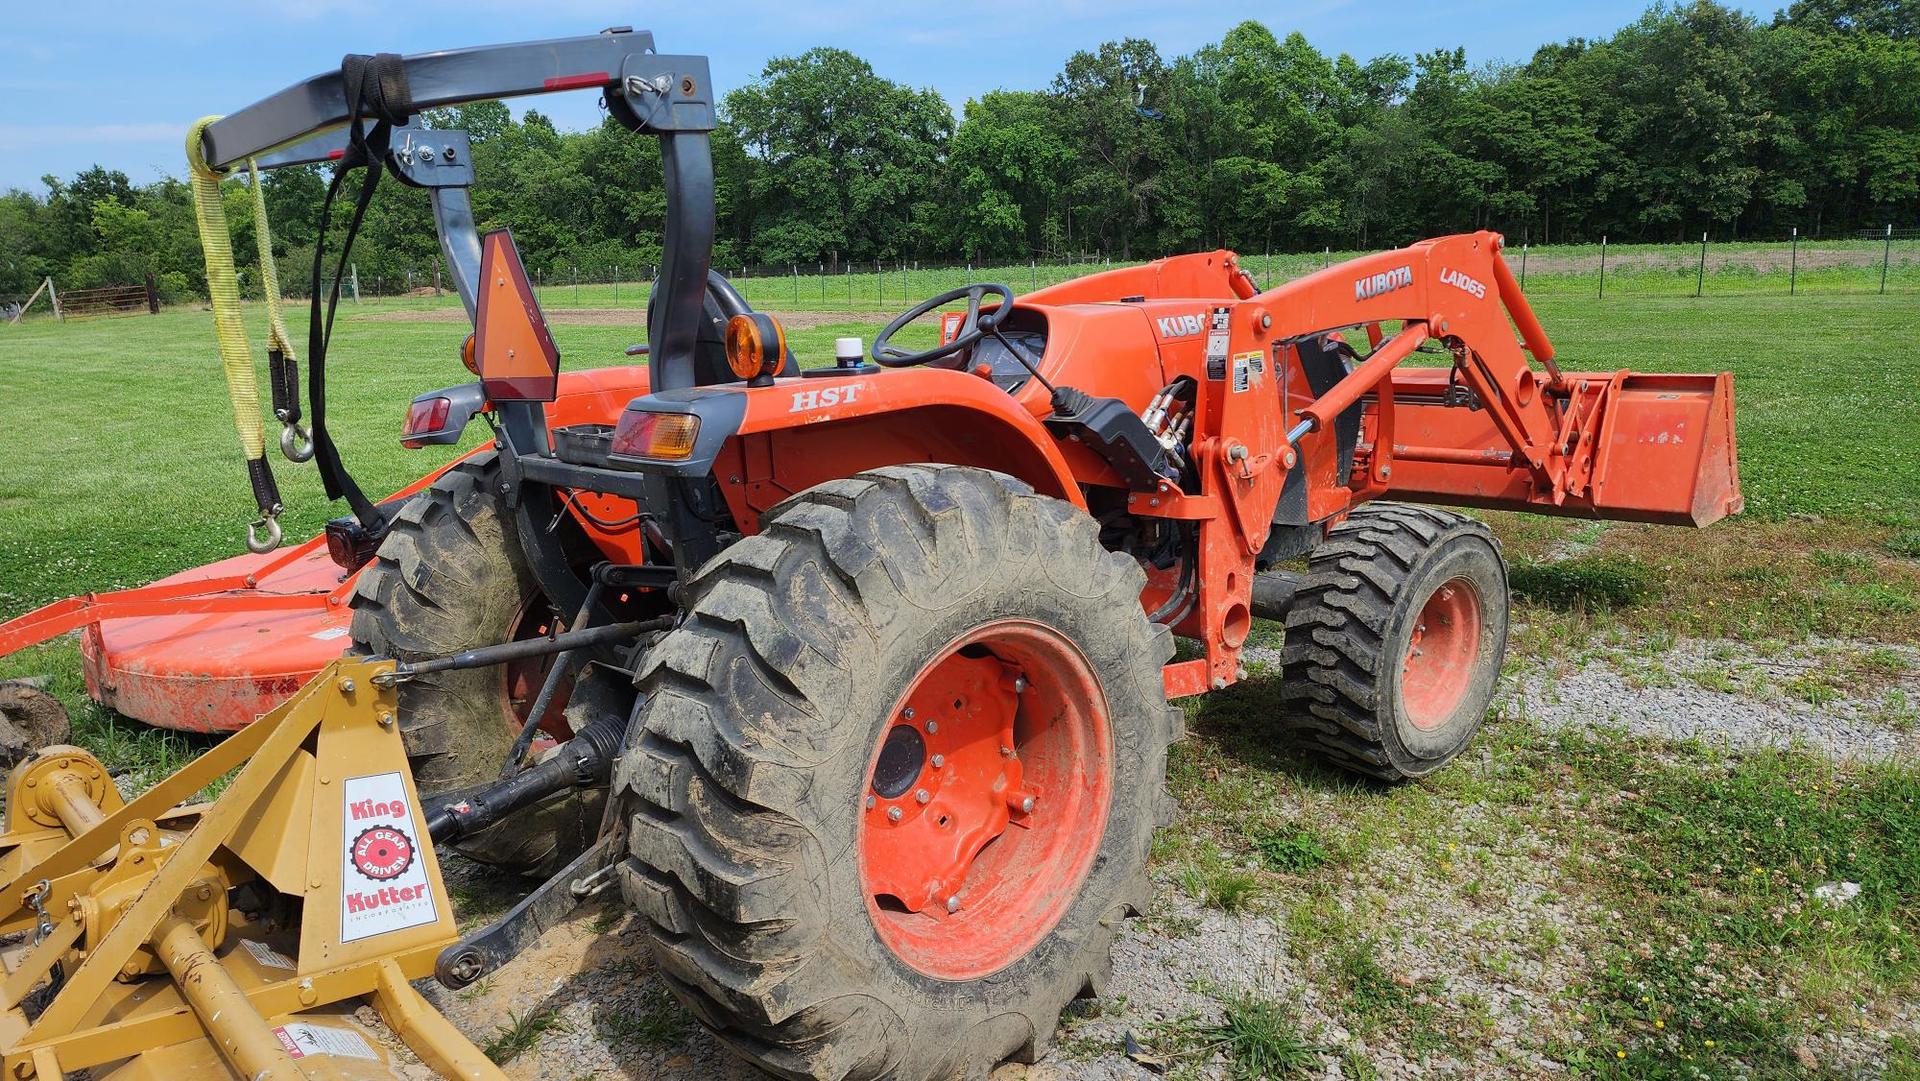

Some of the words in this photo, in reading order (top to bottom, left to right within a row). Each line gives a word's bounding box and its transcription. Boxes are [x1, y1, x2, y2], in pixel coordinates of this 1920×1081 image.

[1355, 266, 1413, 301] KUBOTA
[1440, 267, 1486, 299] LA1065
[788, 383, 865, 413] HST
[350, 799, 406, 820] King
[357, 838, 374, 857] ALL
[375, 831, 406, 850] GEAR
[363, 856, 406, 875] DRIVEN
[346, 883, 427, 914] Kutter
[350, 901, 429, 922] INCORPORATED
